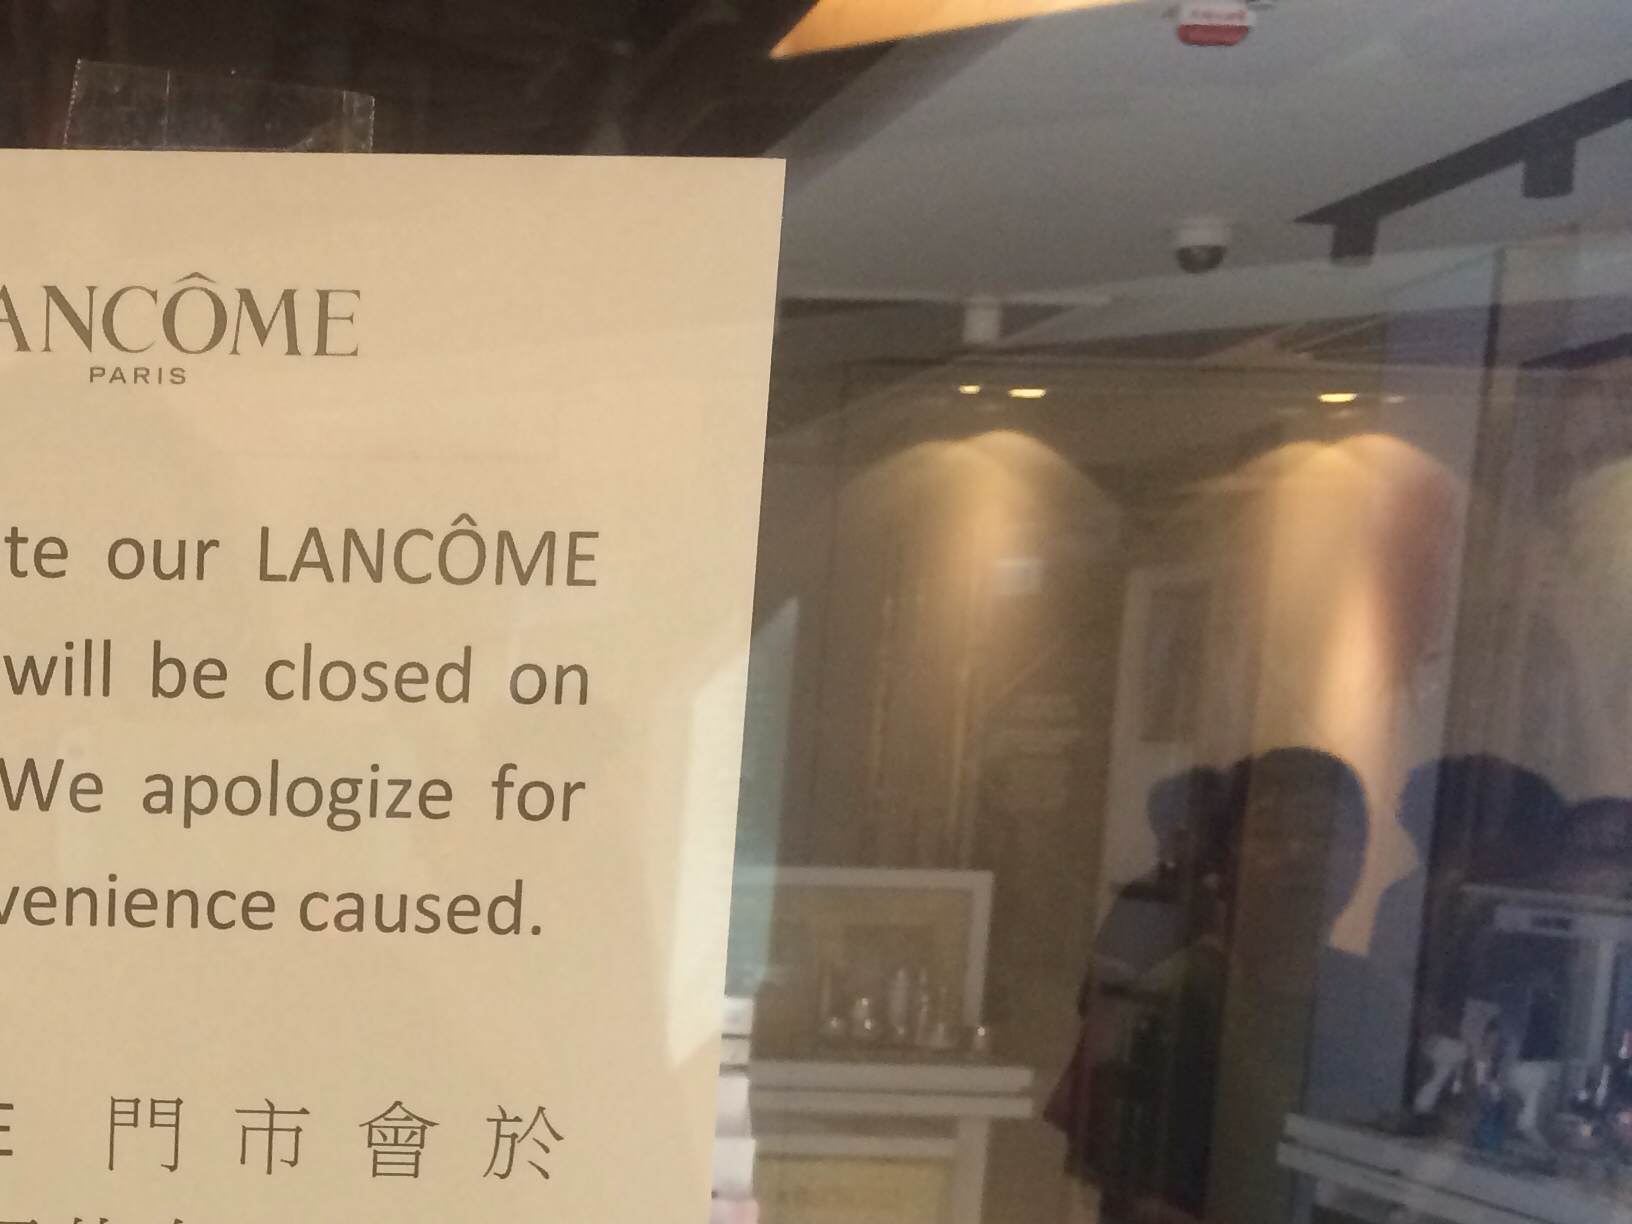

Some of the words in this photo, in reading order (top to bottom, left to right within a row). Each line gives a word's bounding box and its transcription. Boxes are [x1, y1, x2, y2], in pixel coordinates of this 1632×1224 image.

[89, 365, 186, 385] PARIS
[107, 537, 221, 581] our
[259, 512, 600, 587] LANCÔME
[2, 638, 112, 698] will
[151, 639, 228, 700] be
[264, 642, 473, 704] closed
[509, 662, 589, 706] on
[142, 758, 453, 833] apologize
[491, 762, 587, 822] for
[299, 878, 542, 936] caused.
